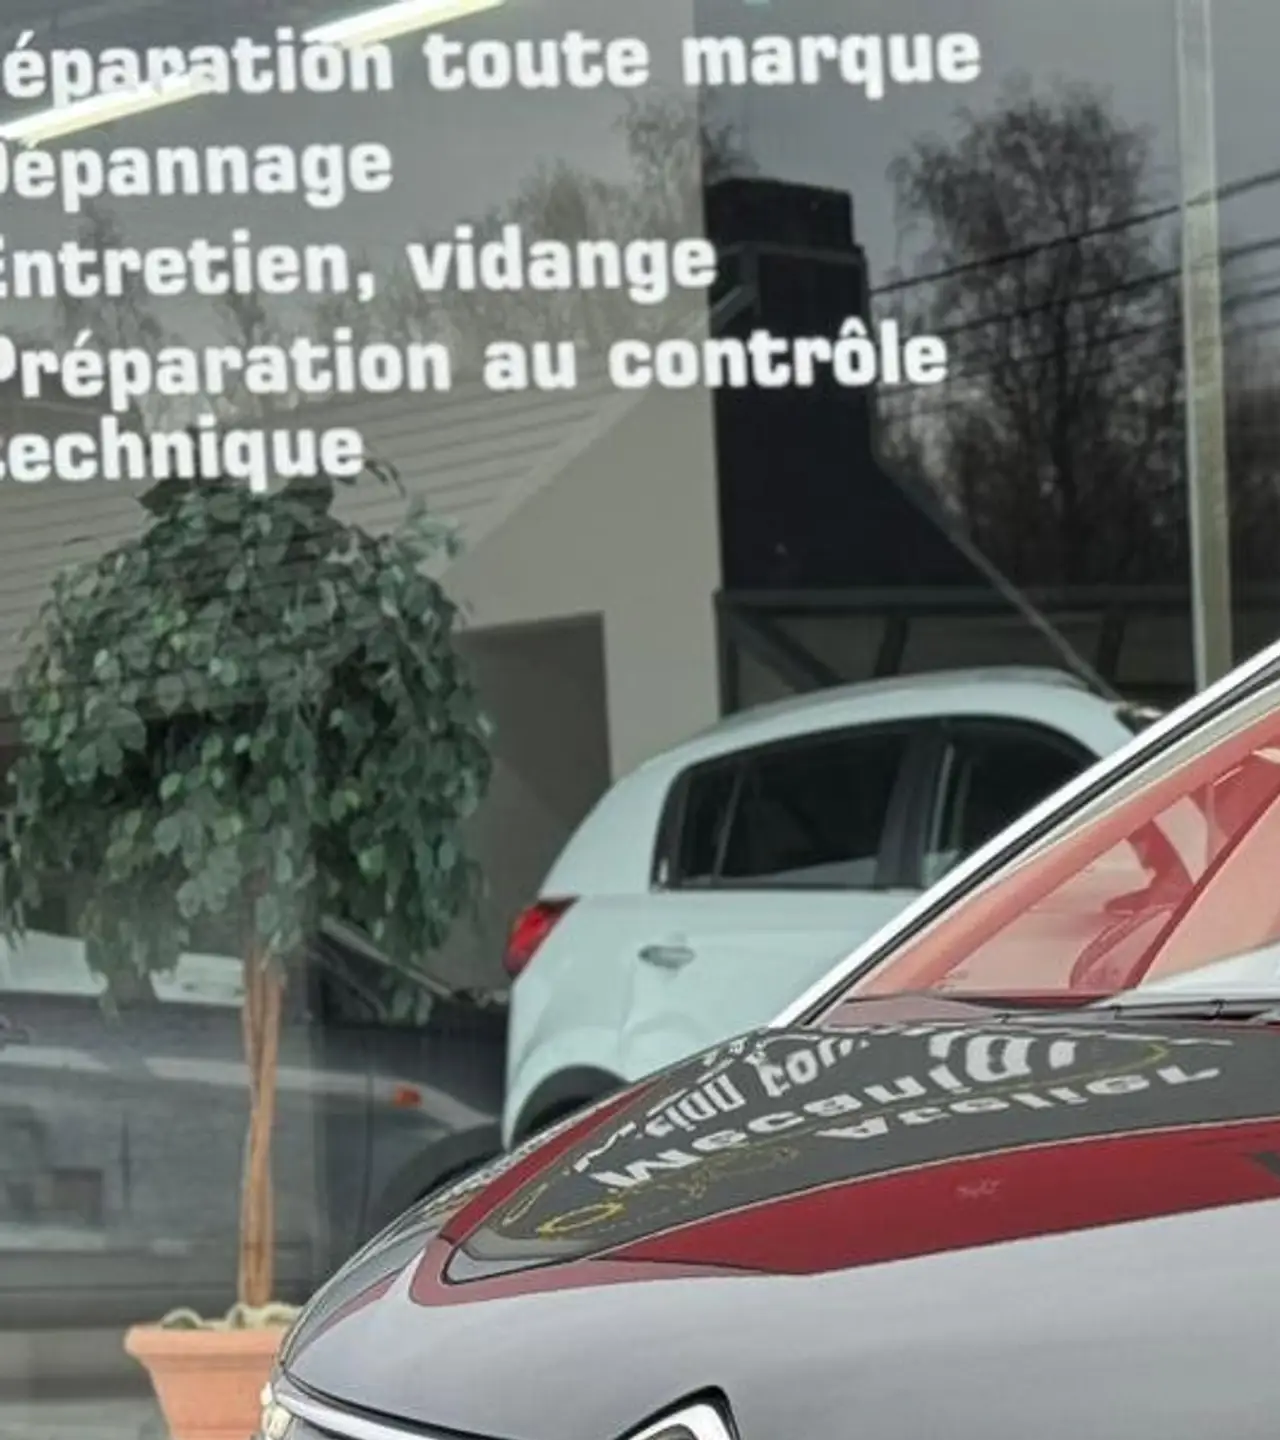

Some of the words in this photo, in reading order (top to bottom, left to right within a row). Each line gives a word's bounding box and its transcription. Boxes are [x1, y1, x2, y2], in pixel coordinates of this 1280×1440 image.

[423, 32, 650, 90] toute
[682, 32, 981, 100] marque
[0, 138, 392, 213] épannage
[0, 228, 376, 302] ntretien,
[406, 225, 716, 304] vidange
[484, 341, 577, 390] au
[608, 318, 947, 388] contrôle
[0, 413, 364, 493] echnique
